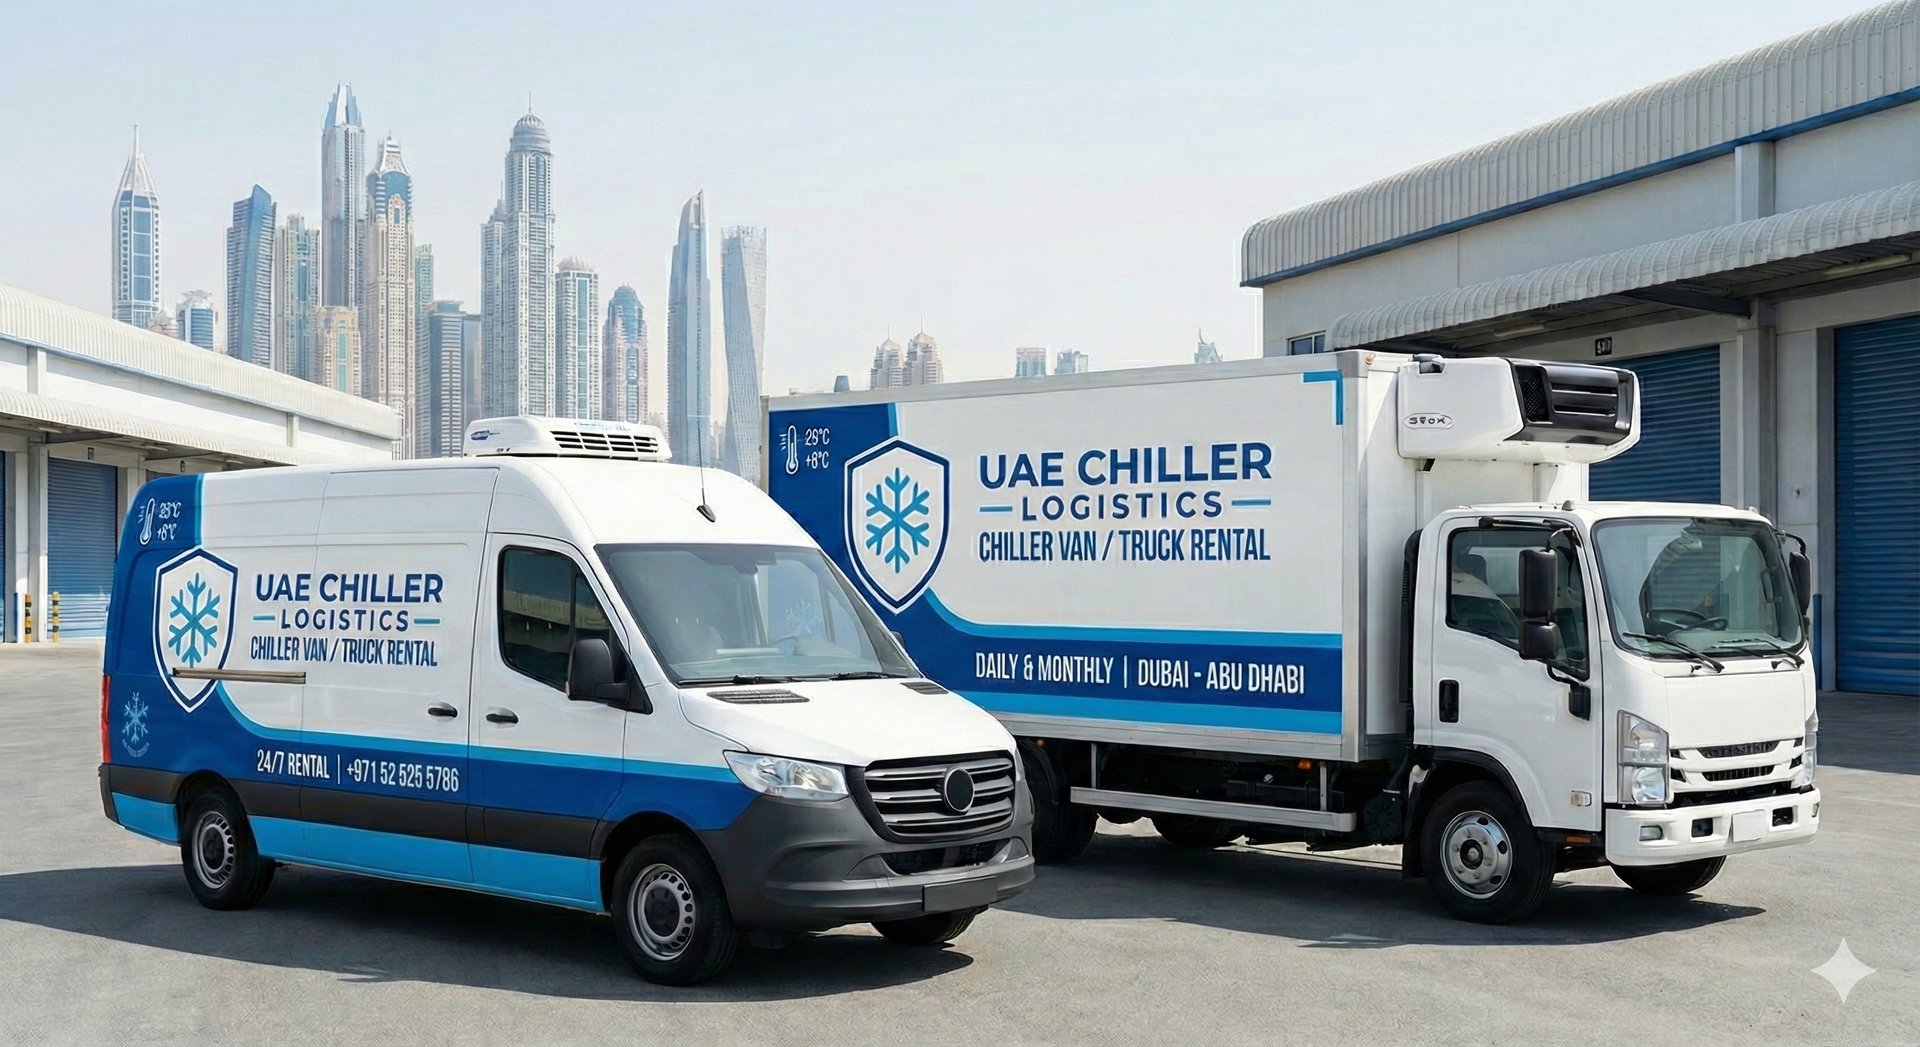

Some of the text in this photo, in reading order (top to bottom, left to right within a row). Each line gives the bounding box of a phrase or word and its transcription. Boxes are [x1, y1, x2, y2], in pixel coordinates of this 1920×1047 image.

[979, 442, 1272, 489] UAE CHILLER
[1022, 490, 1223, 522] LOGISTICS
[979, 530, 1054, 563] CHILLER
[1058, 530, 1097, 562] VAN
[1117, 528, 1186, 562] TRUCK
[1190, 528, 1271, 561] RENTAL
[255, 573, 444, 604] UAE CHILLER
[280, 608, 409, 633] LOGISTICS
[250, 635, 300, 662] CHILLER
[302, 636, 329, 662] VAN
[341, 637, 386, 665] TRUCK
[386, 639, 438, 667] RENTAL
[975, 652, 1019, 680] DAILY
[1023, 654, 1034, 681] &
[1038, 654, 1114, 684] MONTHLY
[1138, 659, 1189, 688] DUBAI
[1206, 661, 1243, 691] ABU
[1248, 663, 1304, 694] DHABI
[257, 749, 285, 774] 24/7
[288, 752, 330, 779] RENTAL
[346, 758, 376, 783] +971
[380, 761, 396, 786] 52
[399, 763, 423, 788] 525
[426, 765, 459, 792] 5786
